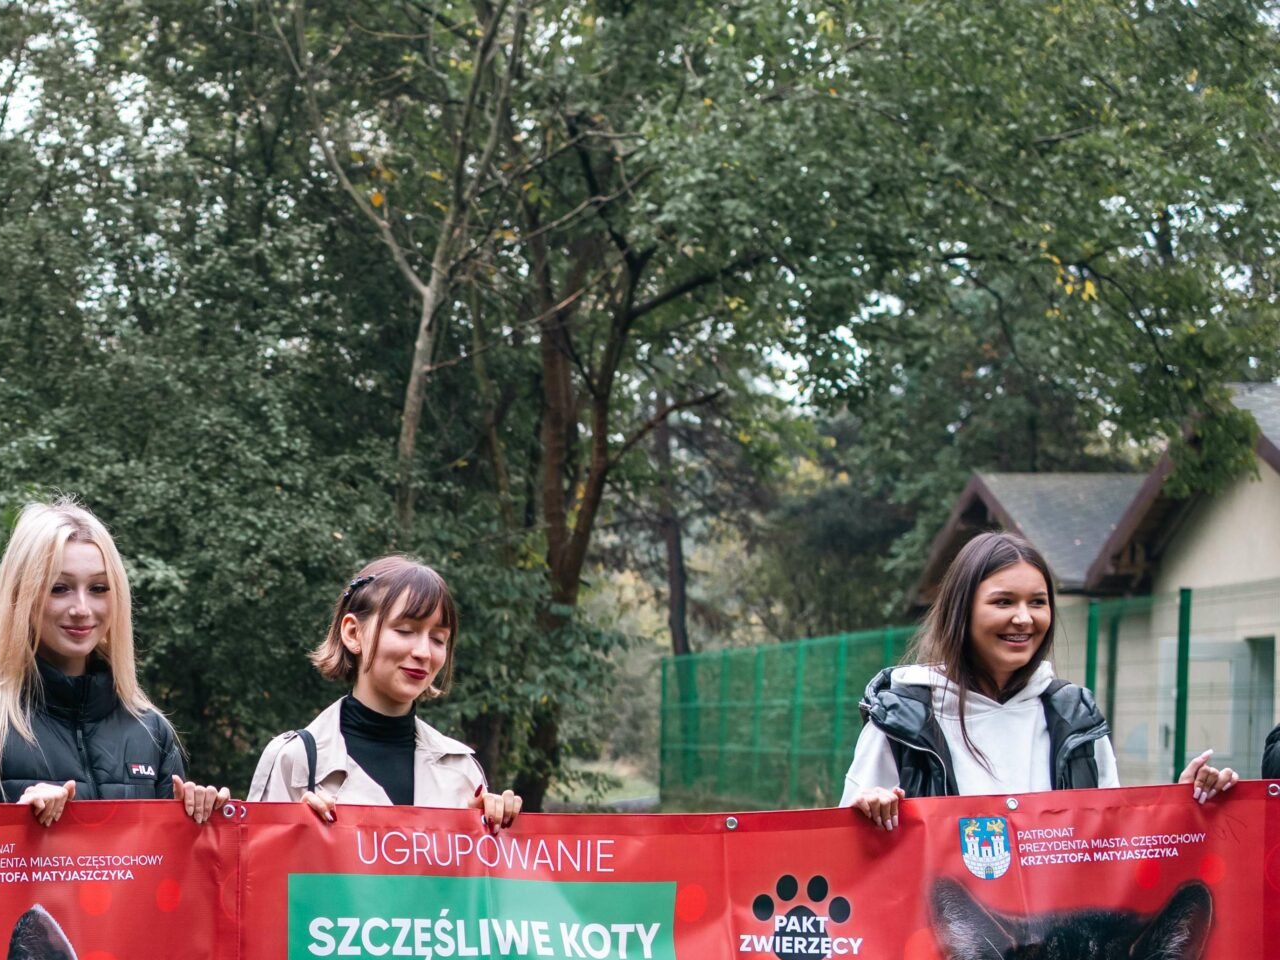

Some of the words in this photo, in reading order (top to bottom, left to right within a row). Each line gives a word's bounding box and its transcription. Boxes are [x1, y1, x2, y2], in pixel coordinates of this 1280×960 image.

[131, 764, 155, 776] FILA
[1017, 827, 1074, 840] PATRONAT
[1019, 839, 1088, 853] PREZYDENTA
[1091, 837, 1129, 849] MIASTA
[1131, 833, 1206, 848] CZĘSTOCHOWY
[356, 831, 615, 873] UGRUPOWANIE
[1020, 853, 1092, 866] KRZYSZTOFA
[1094, 847, 1179, 861] MATYJASZCZYKA
[30, 857, 74, 867] MIASTA
[76, 855, 163, 869] CZĘSTOCHOWY
[32, 870, 134, 881] MATYJASZCZYKA
[774, 915, 828, 934] PAKT
[560, 922, 661, 959] KOTY
[738, 935, 863, 957] ZWIERZĘCY
